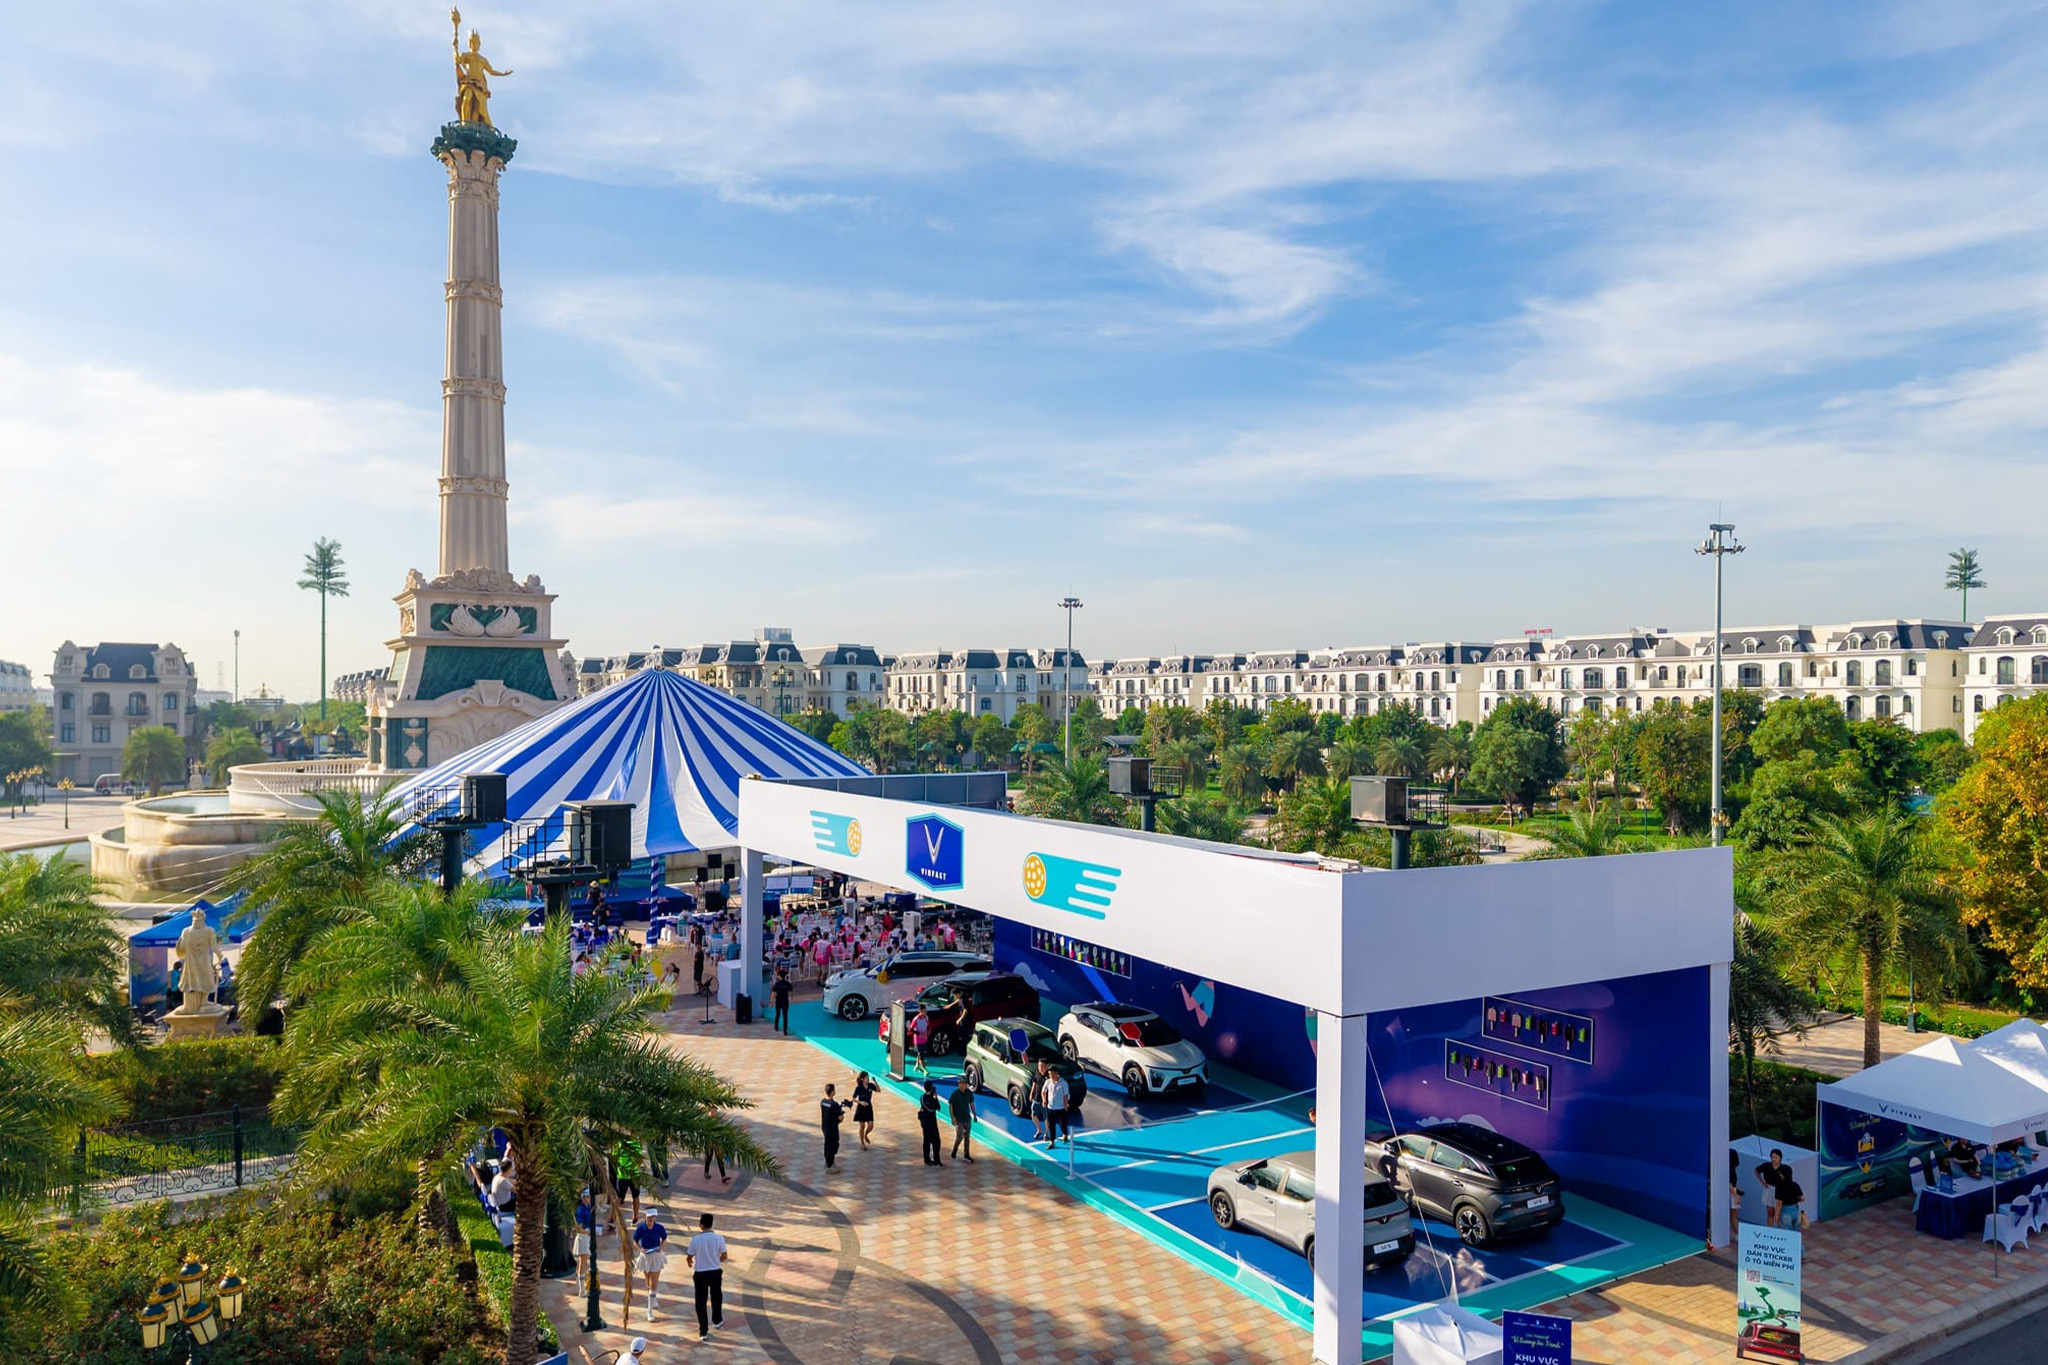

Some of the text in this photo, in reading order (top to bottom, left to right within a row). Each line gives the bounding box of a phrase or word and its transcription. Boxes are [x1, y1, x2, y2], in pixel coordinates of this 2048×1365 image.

[1754, 1243, 1769, 1251] KHU
[1763, 1252, 1793, 1262] STICKER
[1515, 1353, 1535, 1363] KHU
